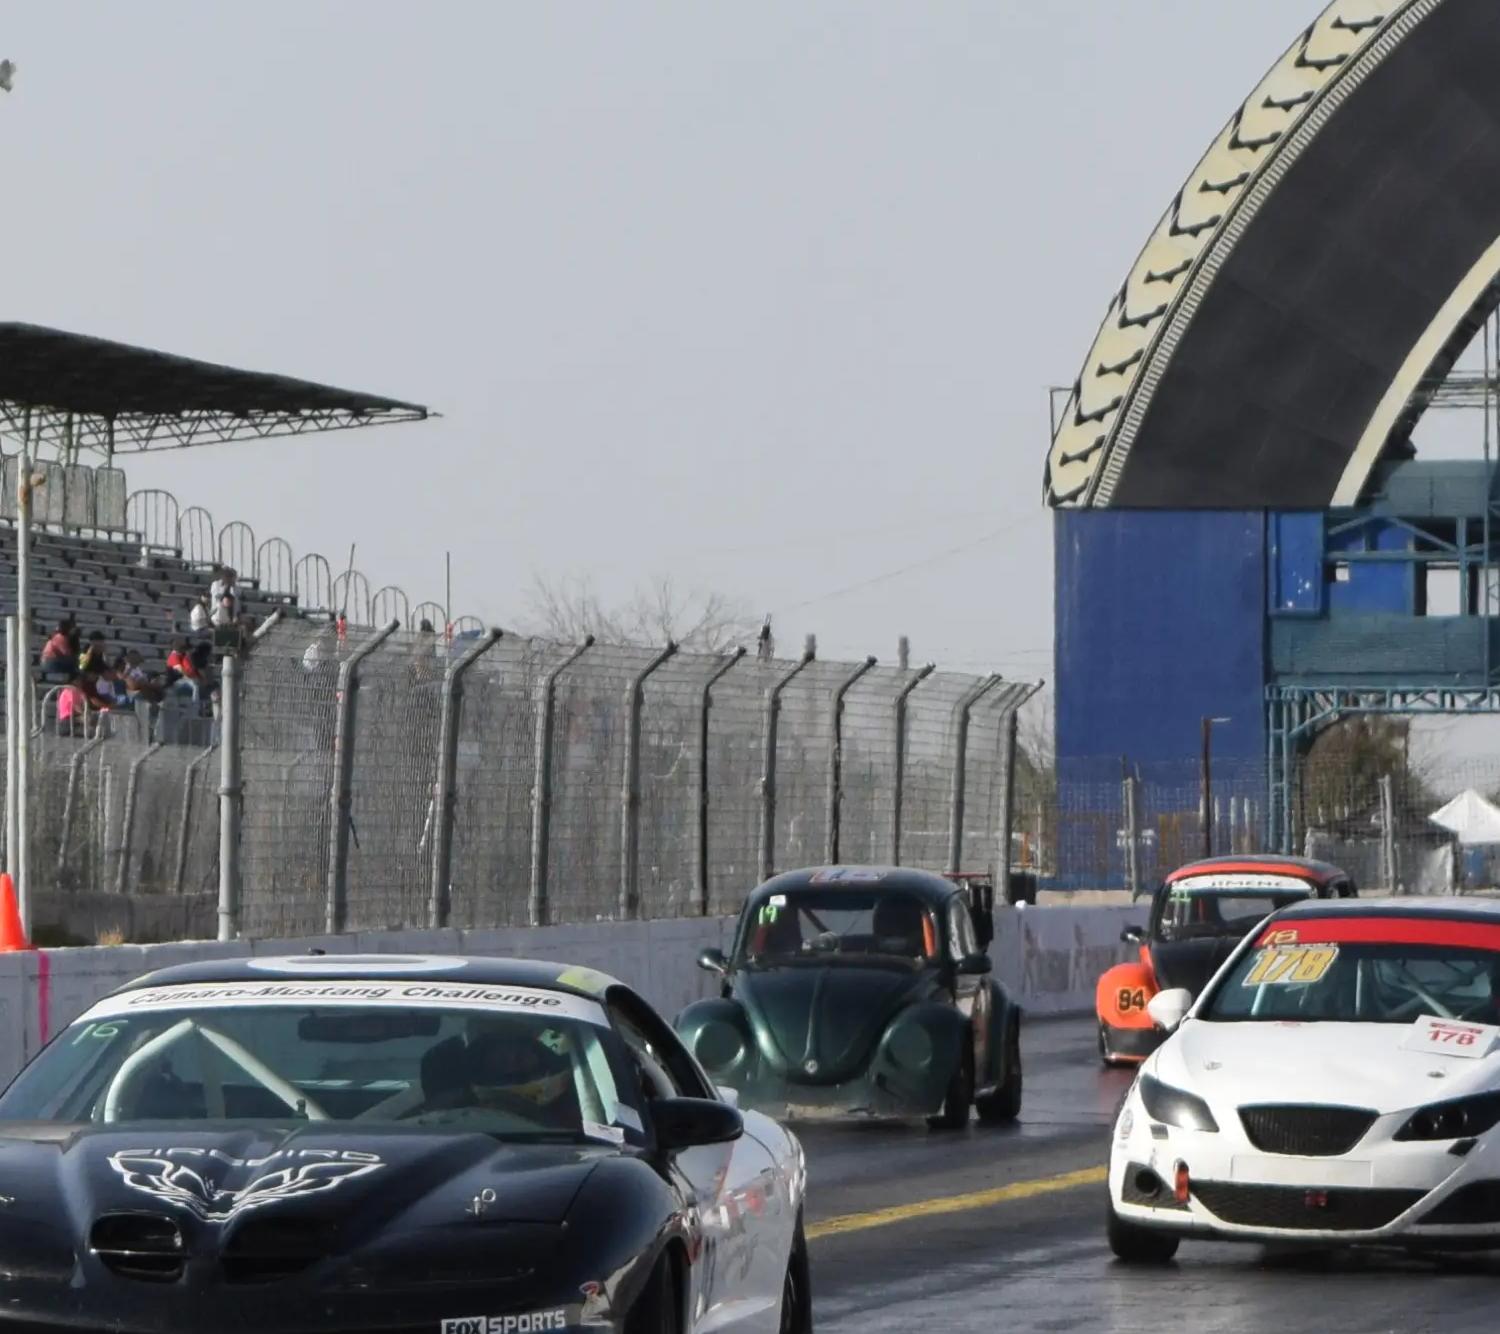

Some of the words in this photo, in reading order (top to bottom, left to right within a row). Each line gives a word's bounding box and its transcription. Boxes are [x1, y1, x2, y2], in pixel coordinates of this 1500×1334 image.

[758, 905, 778, 925] 19
[1262, 929, 1298, 945] 18
[1241, 946, 1340, 986] 178
[128, 984, 392, 1005] Camaro-Mustang
[401, 985, 563, 1007] Challenge
[1118, 988, 1145, 1011] 94
[70, 1019, 129, 1047] 16
[1428, 1029, 1477, 1046] 178
